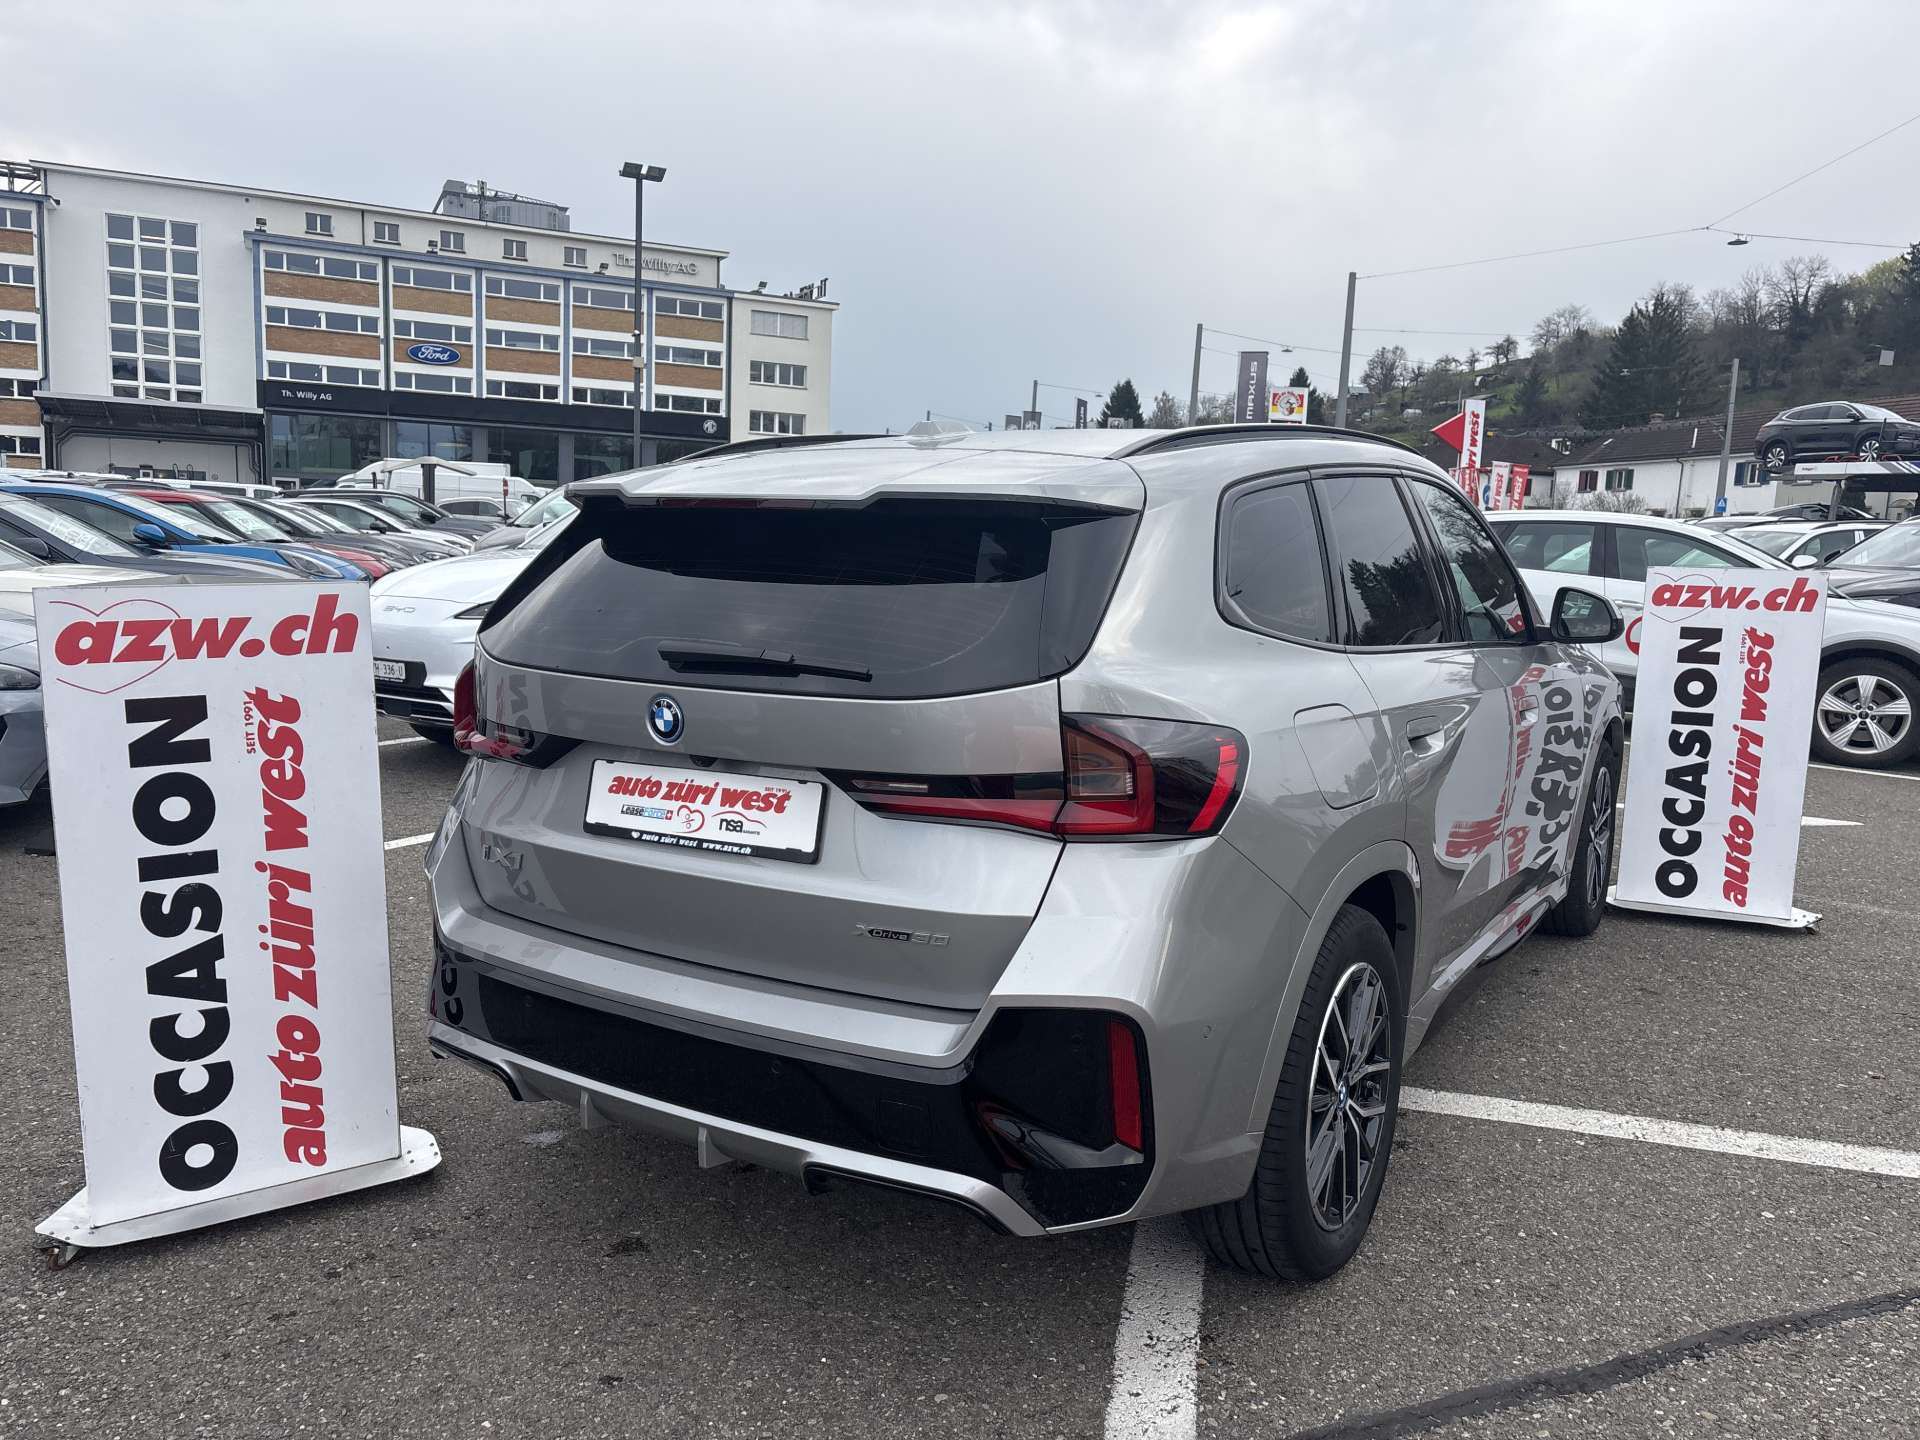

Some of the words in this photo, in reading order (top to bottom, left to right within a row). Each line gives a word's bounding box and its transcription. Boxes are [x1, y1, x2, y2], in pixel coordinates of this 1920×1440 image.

[675, 261, 698, 275] AG
[418, 346, 450, 361] Ford
[296, 390, 318, 401] Willy
[319, 393, 333, 401] AG
[1650, 577, 1819, 613] azw.ch
[54, 594, 360, 666] azw.ch
[383, 663, 396, 676] 336
[1740, 626, 1775, 722] west
[243, 701, 253, 728] 1991
[246, 731, 257, 754] SEIT
[243, 686, 308, 852] west
[1655, 626, 1723, 899] OCCASION
[1728, 723, 1764, 817] züri
[607, 775, 663, 798] auto
[660, 778, 720, 805] züri
[719, 787, 792, 814] west
[641, 833, 659, 842] auto
[679, 839, 698, 848] west
[702, 842, 752, 855] www.azw.ch
[719, 818, 743, 833] nsa
[1722, 814, 1754, 908] auto
[124, 694, 239, 1192] OCCASION
[254, 860, 319, 1010] züri
[267, 1014, 327, 1167] auto
